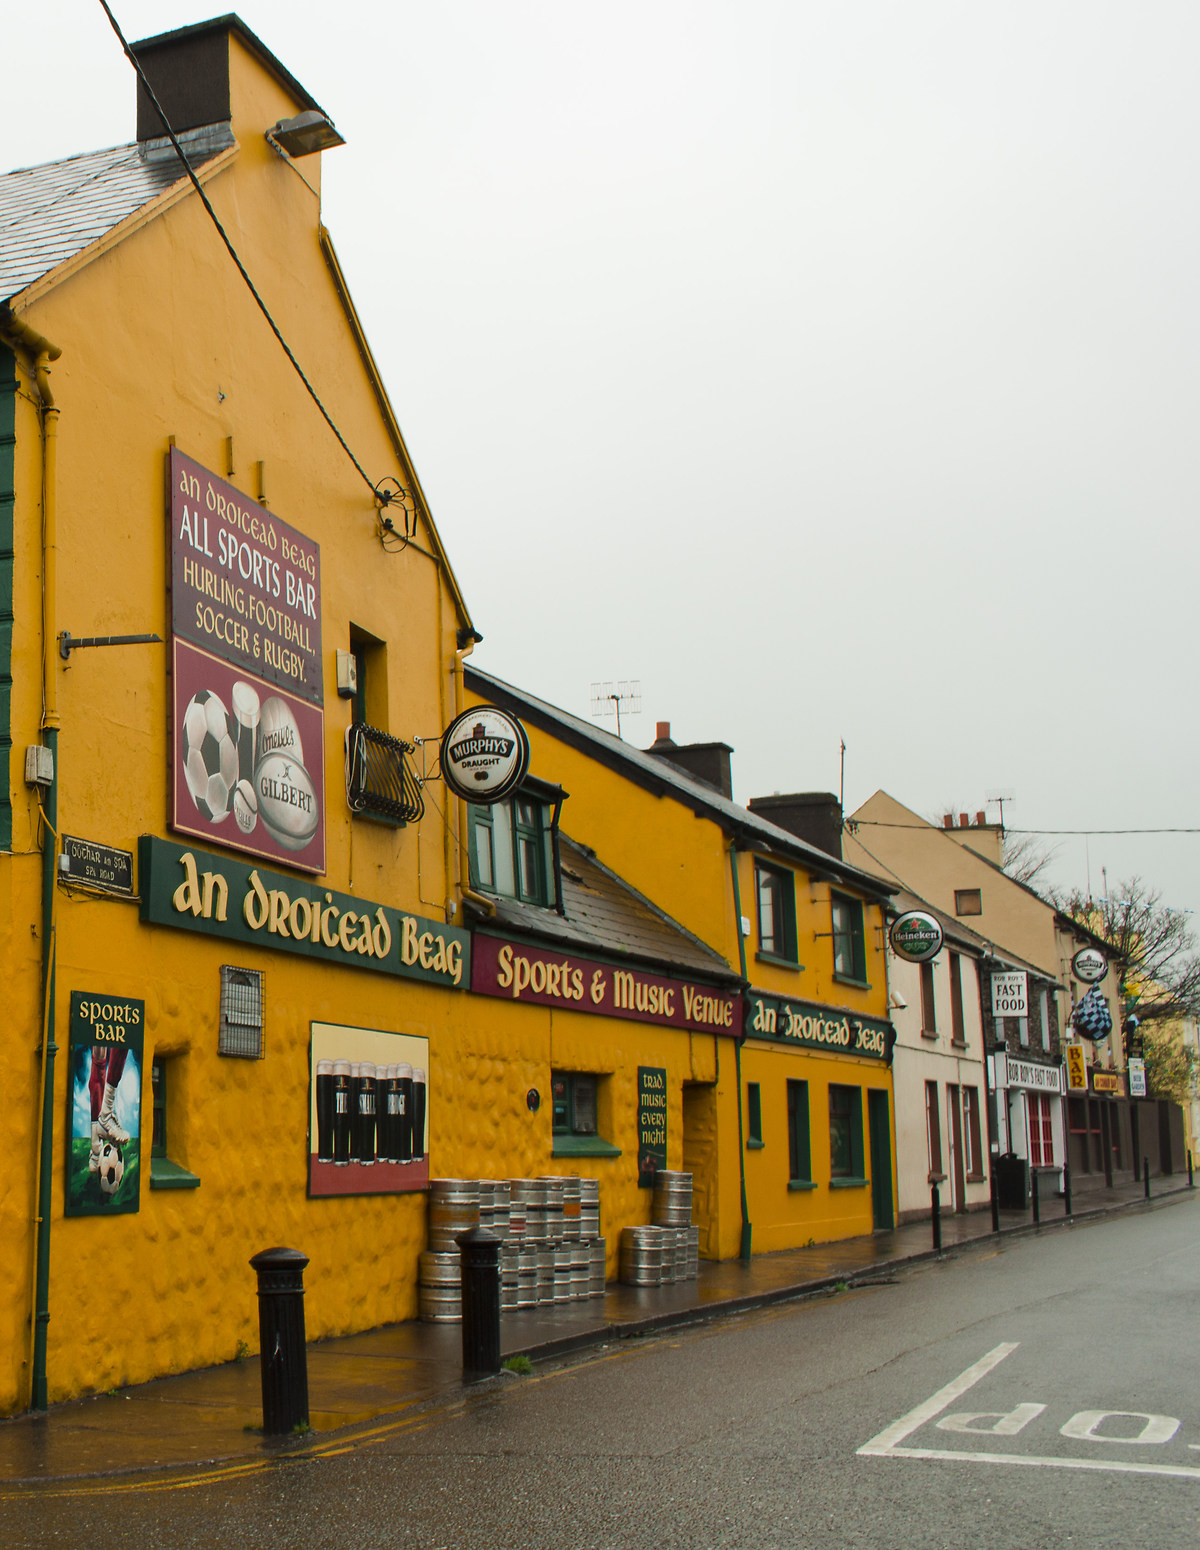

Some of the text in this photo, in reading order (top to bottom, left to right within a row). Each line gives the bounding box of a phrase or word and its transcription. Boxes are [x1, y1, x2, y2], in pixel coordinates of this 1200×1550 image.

[179, 504, 317, 621] ALL SPORTS BAR
[196, 601, 307, 683] SOCCER & RUGBY.
[453, 739, 509, 759] MURPHY'S
[461, 758, 500, 769] DRAUGHT
[260, 777, 312, 814] GILBERT
[85, 865, 115, 881] SPA ROAD
[895, 931, 937, 941] Heineken
[497, 945, 734, 1028] Sports & Music Venue
[996, 984, 1023, 996] FAST
[996, 999, 1025, 1011] FOOD
[1008, 1061, 1058, 1087] ROB ROY'S FAST FOOD
